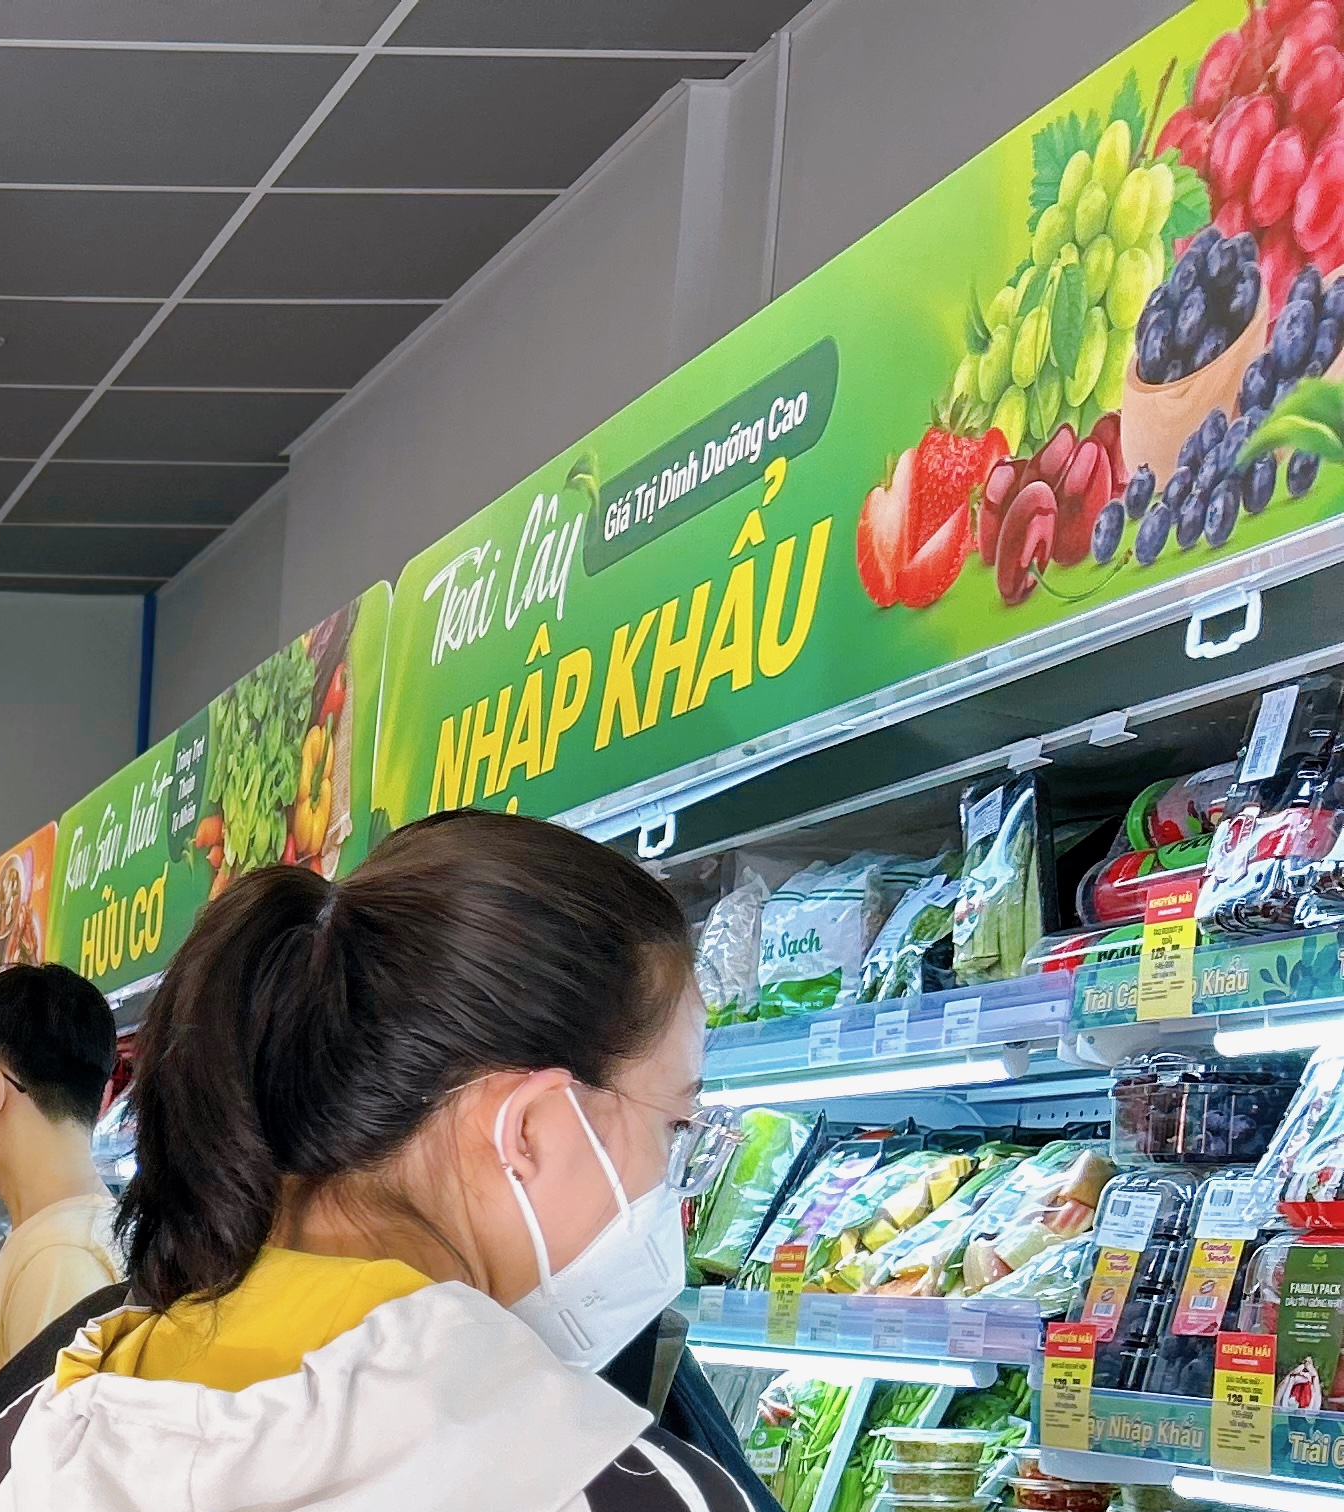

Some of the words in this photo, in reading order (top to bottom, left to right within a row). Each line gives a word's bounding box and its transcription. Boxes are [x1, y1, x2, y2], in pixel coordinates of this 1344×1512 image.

[603, 487, 631, 543] Giá
[633, 481, 657, 526] Trị
[659, 452, 699, 510] Dinh
[702, 422, 764, 476] Dưỡng
[766, 391, 809, 443] Cao
[423, 539, 501, 666] Trái
[504, 493, 585, 630] Cây
[427, 621, 593, 814] NHẬP
[594, 457, 833, 752] KHẨU
[79, 884, 128, 981] HỮU
[129, 860, 170, 962] CƠ
[778, 928, 823, 963] Sạch
[1083, 982, 1114, 1013] Trái
[1117, 977, 1139, 1009] Câ
[1202, 954, 1250, 997] Khẩu
[1290, 1282, 1319, 1295] FAMILY
[1320, 1283, 1341, 1295] PACK
[1222, 1342, 1254, 1356] KHUYẾN
[1255, 1344, 1271, 1357] MÃI
[1088, 1412, 1106, 1441] ây
[1108, 1413, 1153, 1448] Nhập
[1158, 1412, 1205, 1449] Khẩu
[1289, 1430, 1330, 1466] Trái
